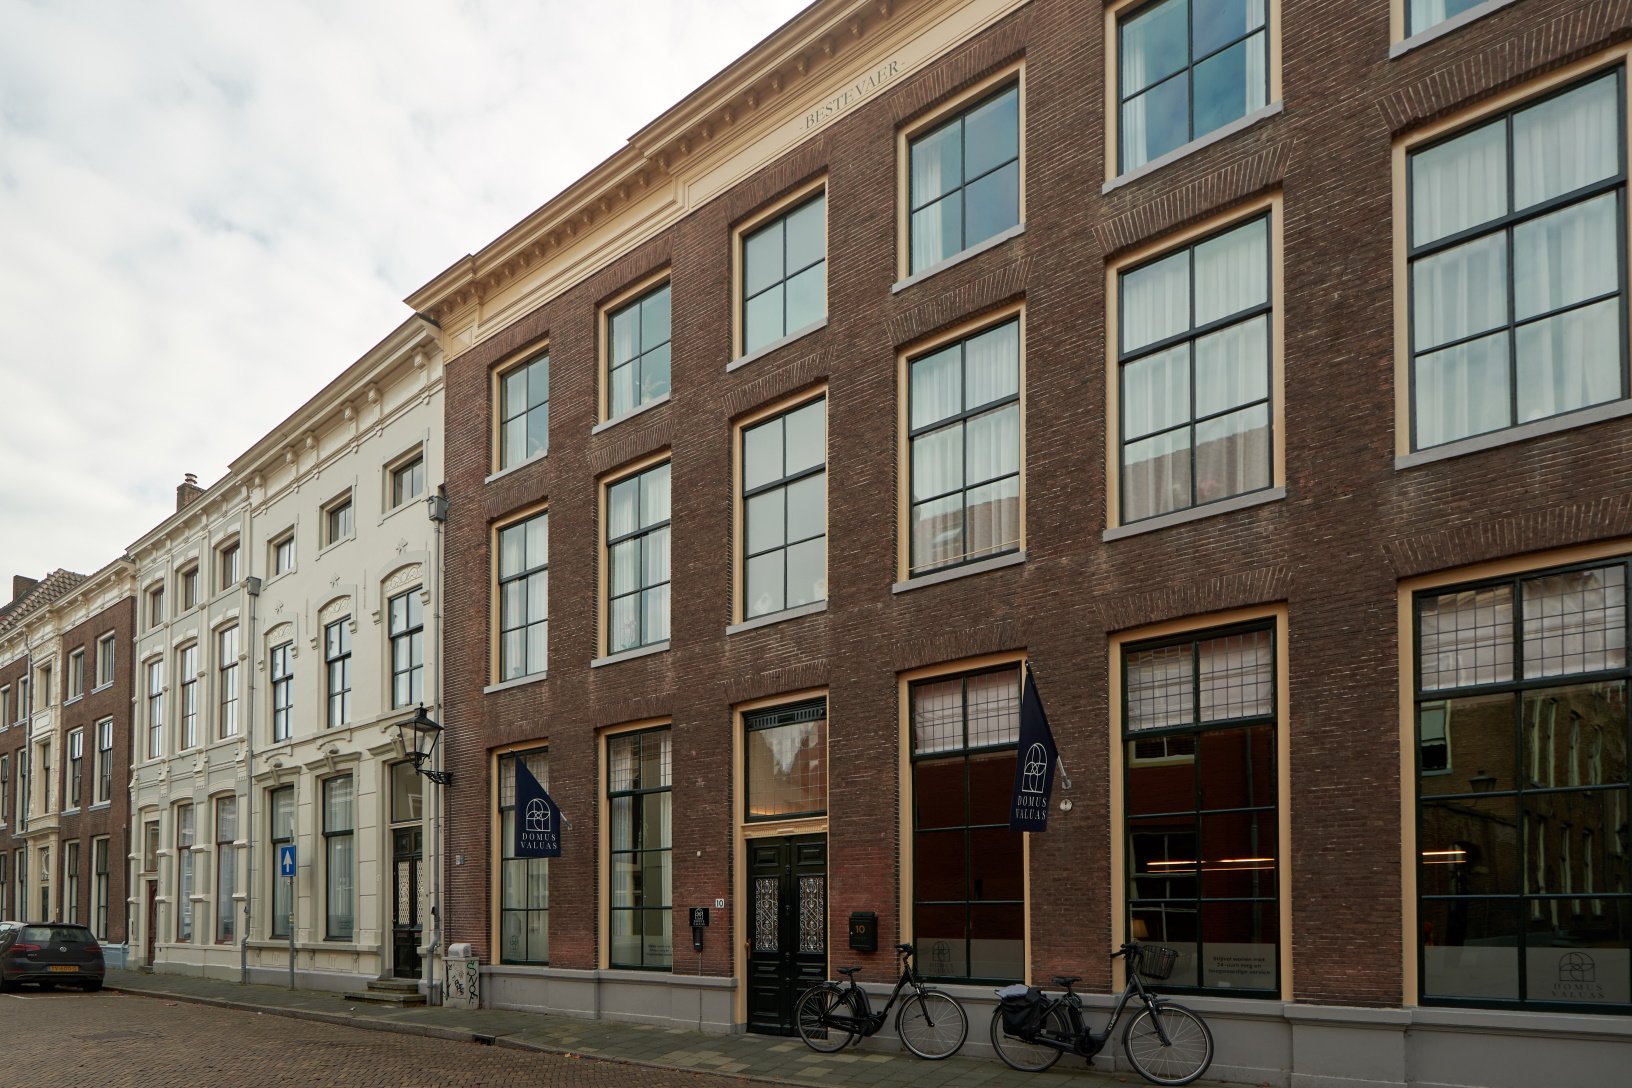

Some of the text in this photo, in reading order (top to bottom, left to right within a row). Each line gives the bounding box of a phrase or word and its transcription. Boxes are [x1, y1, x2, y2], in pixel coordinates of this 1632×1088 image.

[805, 60, 899, 129] BESTEVAER
[1017, 795, 1048, 808] DOMUS
[1015, 808, 1047, 820] VALUAS
[522, 832, 557, 841] DOMUS
[520, 841, 558, 850] VALUAS
[716, 899, 724, 907] 10
[855, 925, 865, 934] 10
